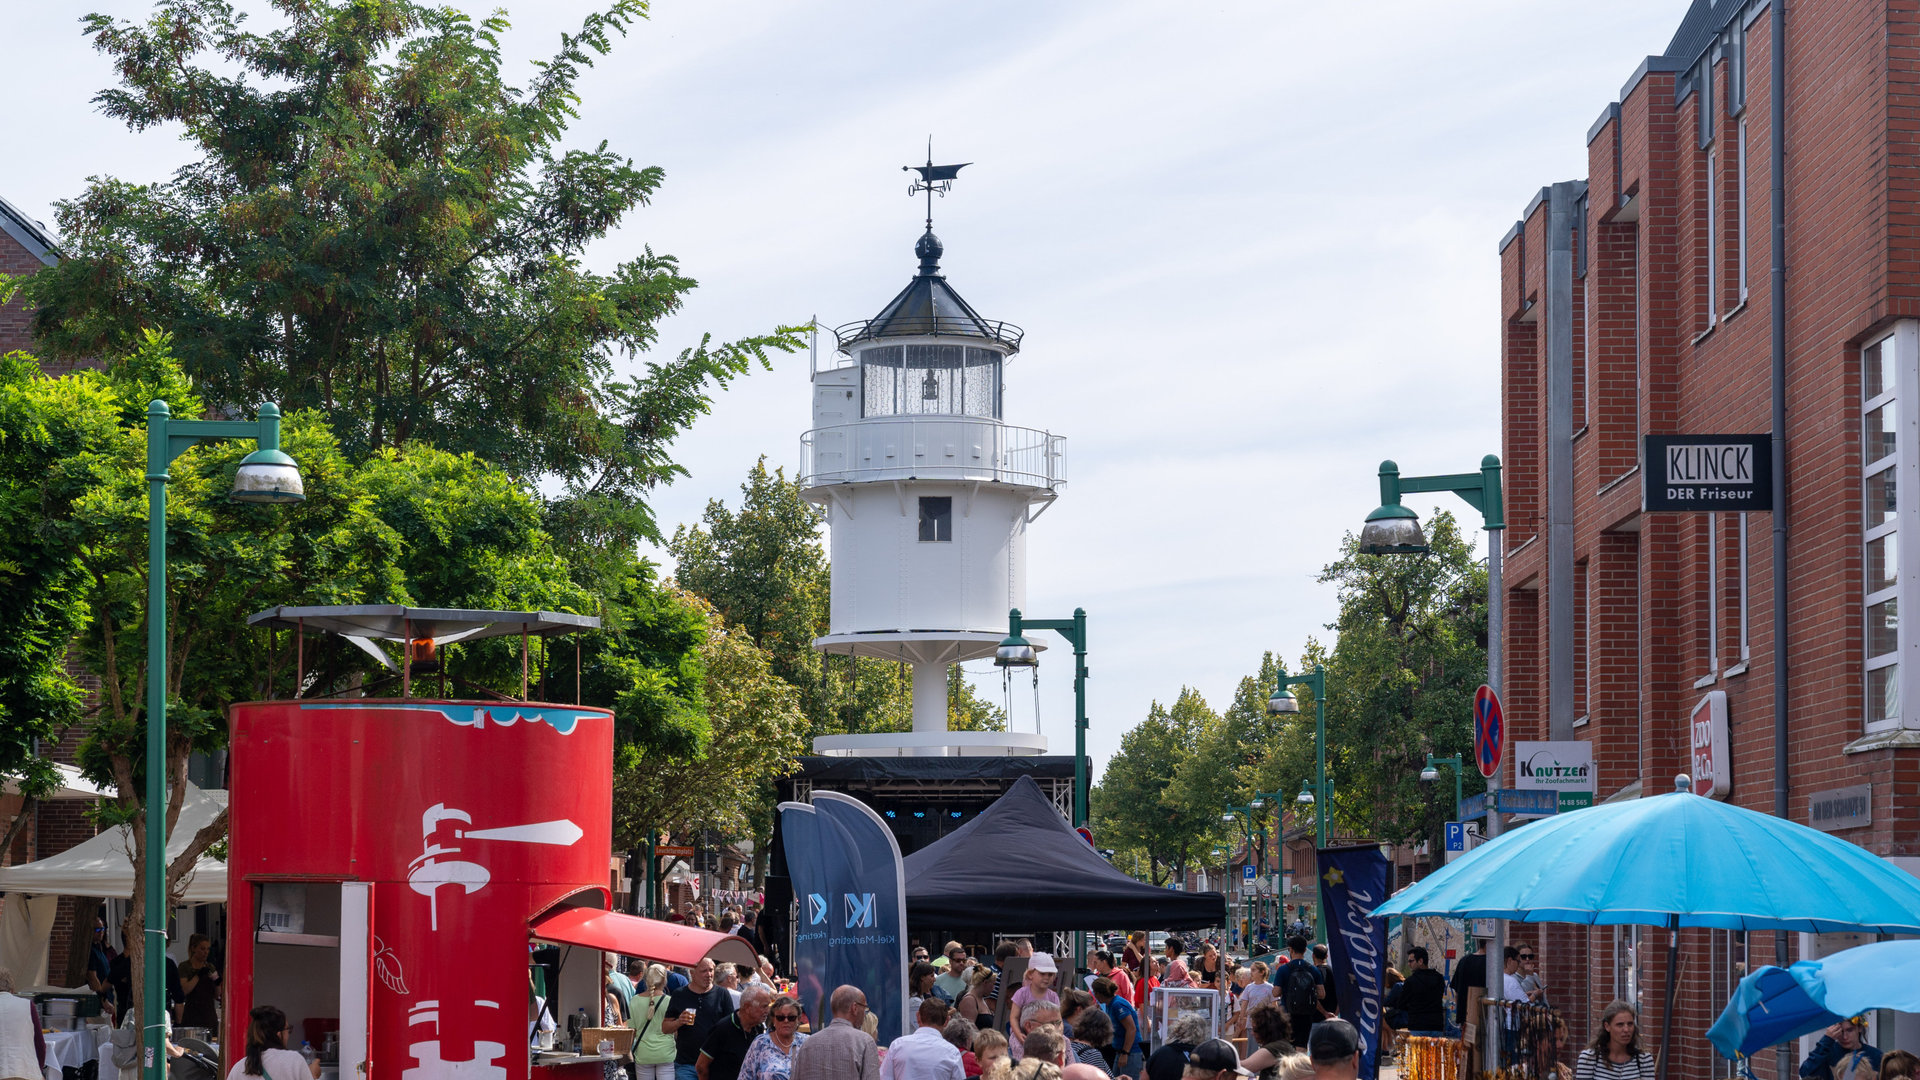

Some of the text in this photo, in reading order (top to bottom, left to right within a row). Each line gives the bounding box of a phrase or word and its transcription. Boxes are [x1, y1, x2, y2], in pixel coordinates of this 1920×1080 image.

[1670, 447, 1749, 480] KLINCK
[1667, 487, 1753, 500] DER Friseur
[1451, 825, 1459, 839] P
[1453, 842, 1462, 850] P2
[1246, 867, 1253, 877] P
[1340, 890, 1378, 1056] ioladen
